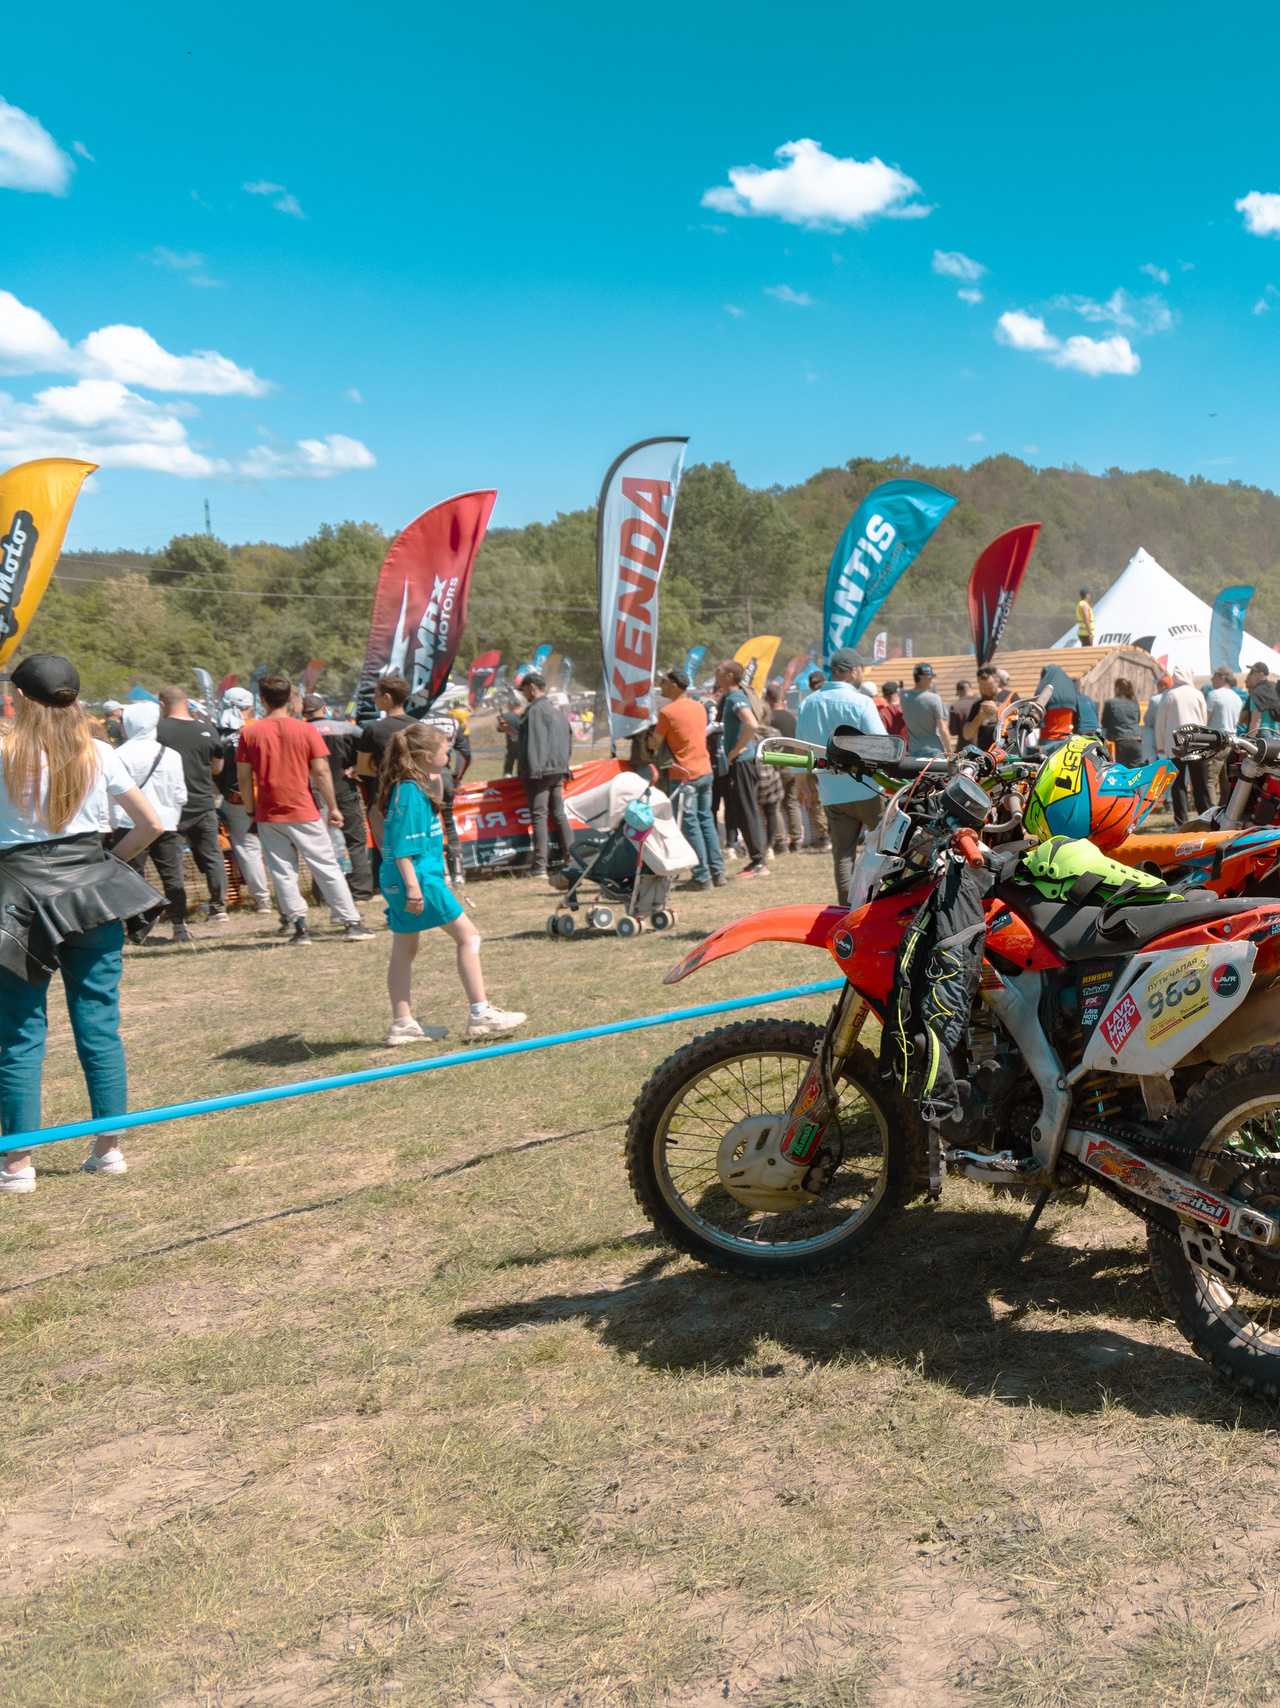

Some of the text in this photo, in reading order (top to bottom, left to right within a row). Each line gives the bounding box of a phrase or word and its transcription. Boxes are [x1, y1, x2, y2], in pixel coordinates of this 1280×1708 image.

[611, 477, 671, 720] KENDA
[437, 576, 459, 652] MOTORS
[986, 915, 1008, 928] LAVR
[835, 937, 851, 950] LAVR
[1082, 971, 1114, 984] HINSON
[1147, 957, 1198, 993] ПУТЬ ЧАПАЯ
[1085, 996, 1099, 1006] FX
[1106, 997, 1131, 1031] LAVR
[1110, 1004, 1136, 1040] MOTO
[1111, 1020, 1132, 1050] LINE
[794, 1125, 813, 1155] energy
